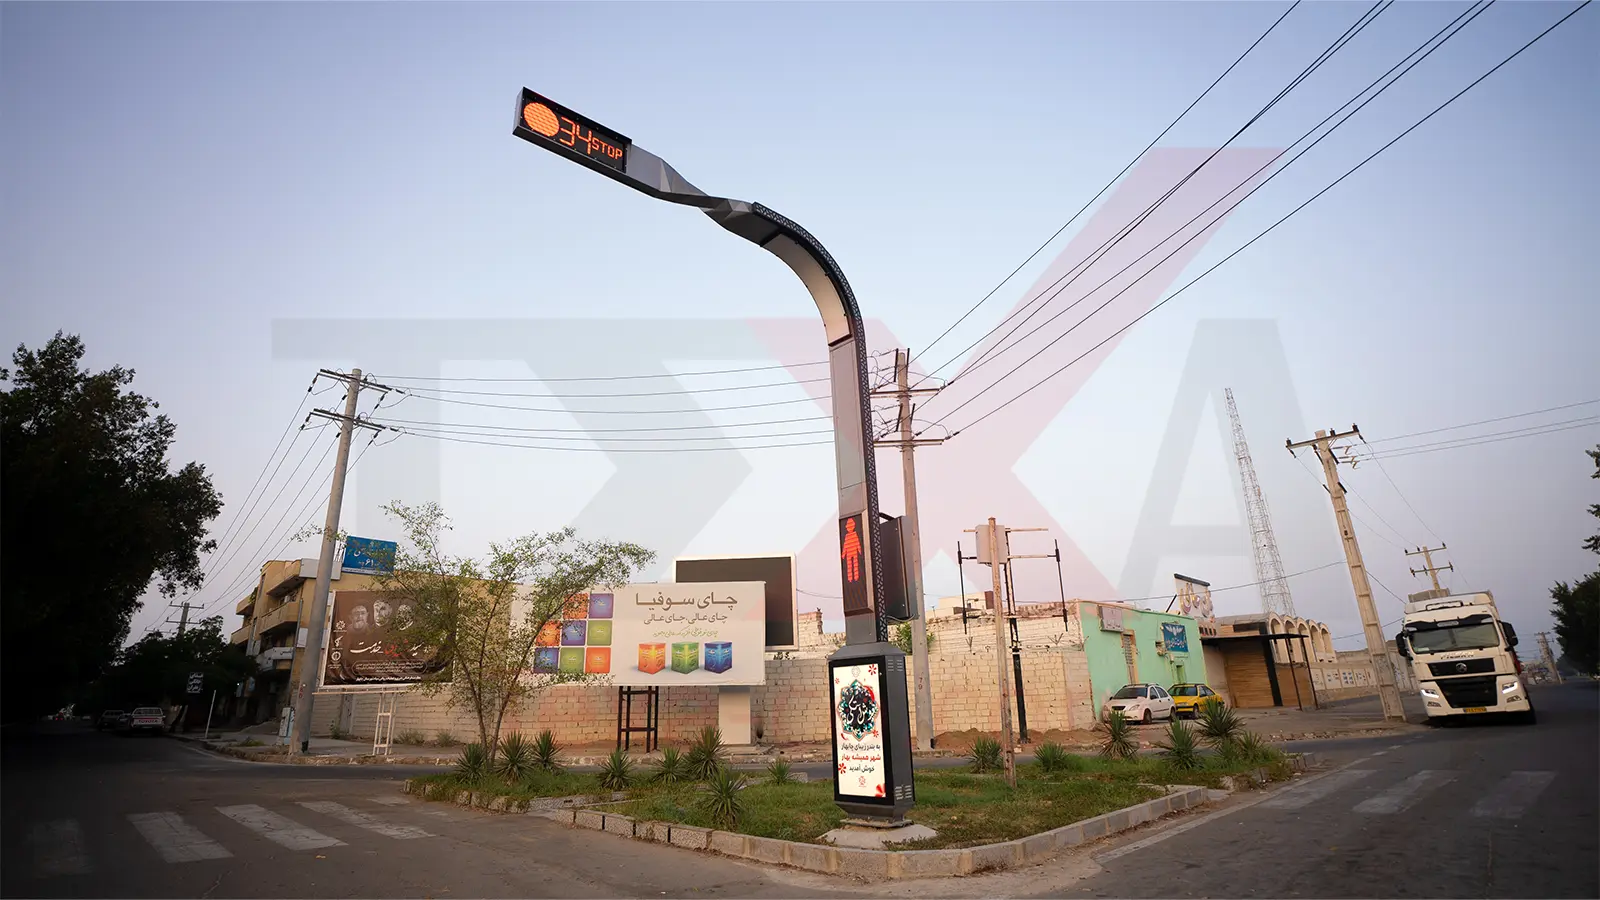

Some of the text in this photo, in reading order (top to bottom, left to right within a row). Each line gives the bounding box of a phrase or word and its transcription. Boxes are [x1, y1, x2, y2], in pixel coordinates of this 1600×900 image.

[559, 116, 623, 160] 34 STOP
[635, 591, 738, 611] چای سوفیا
[643, 613, 665, 625] عالی
[665, 613, 685, 624] جای
[707, 612, 728, 624] چای
[841, 753, 882, 762] شهر همیشه بهار
[848, 764, 875, 773] خوش آمدید
